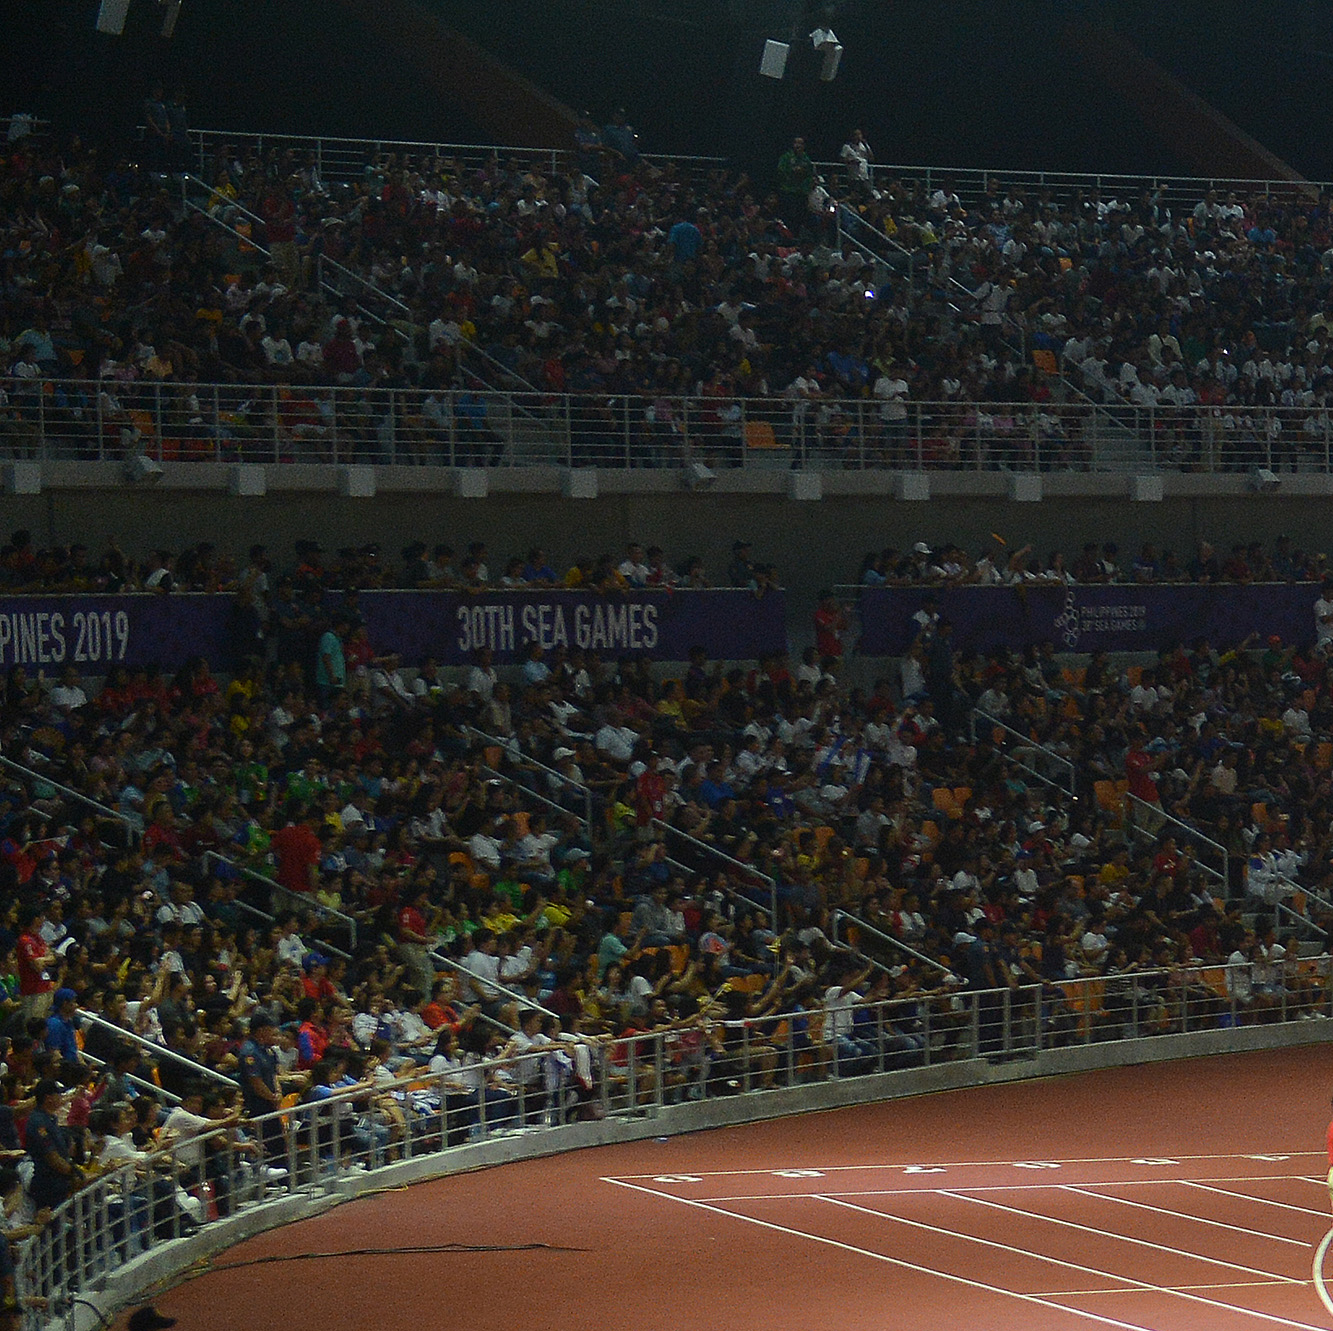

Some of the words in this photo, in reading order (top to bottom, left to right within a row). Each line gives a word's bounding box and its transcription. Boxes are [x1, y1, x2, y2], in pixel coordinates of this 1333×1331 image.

[73, 609, 129, 662] 2019
[456, 604, 515, 652] 30TH
[521, 604, 570, 650] SEA
[575, 603, 660, 650] GAMES
